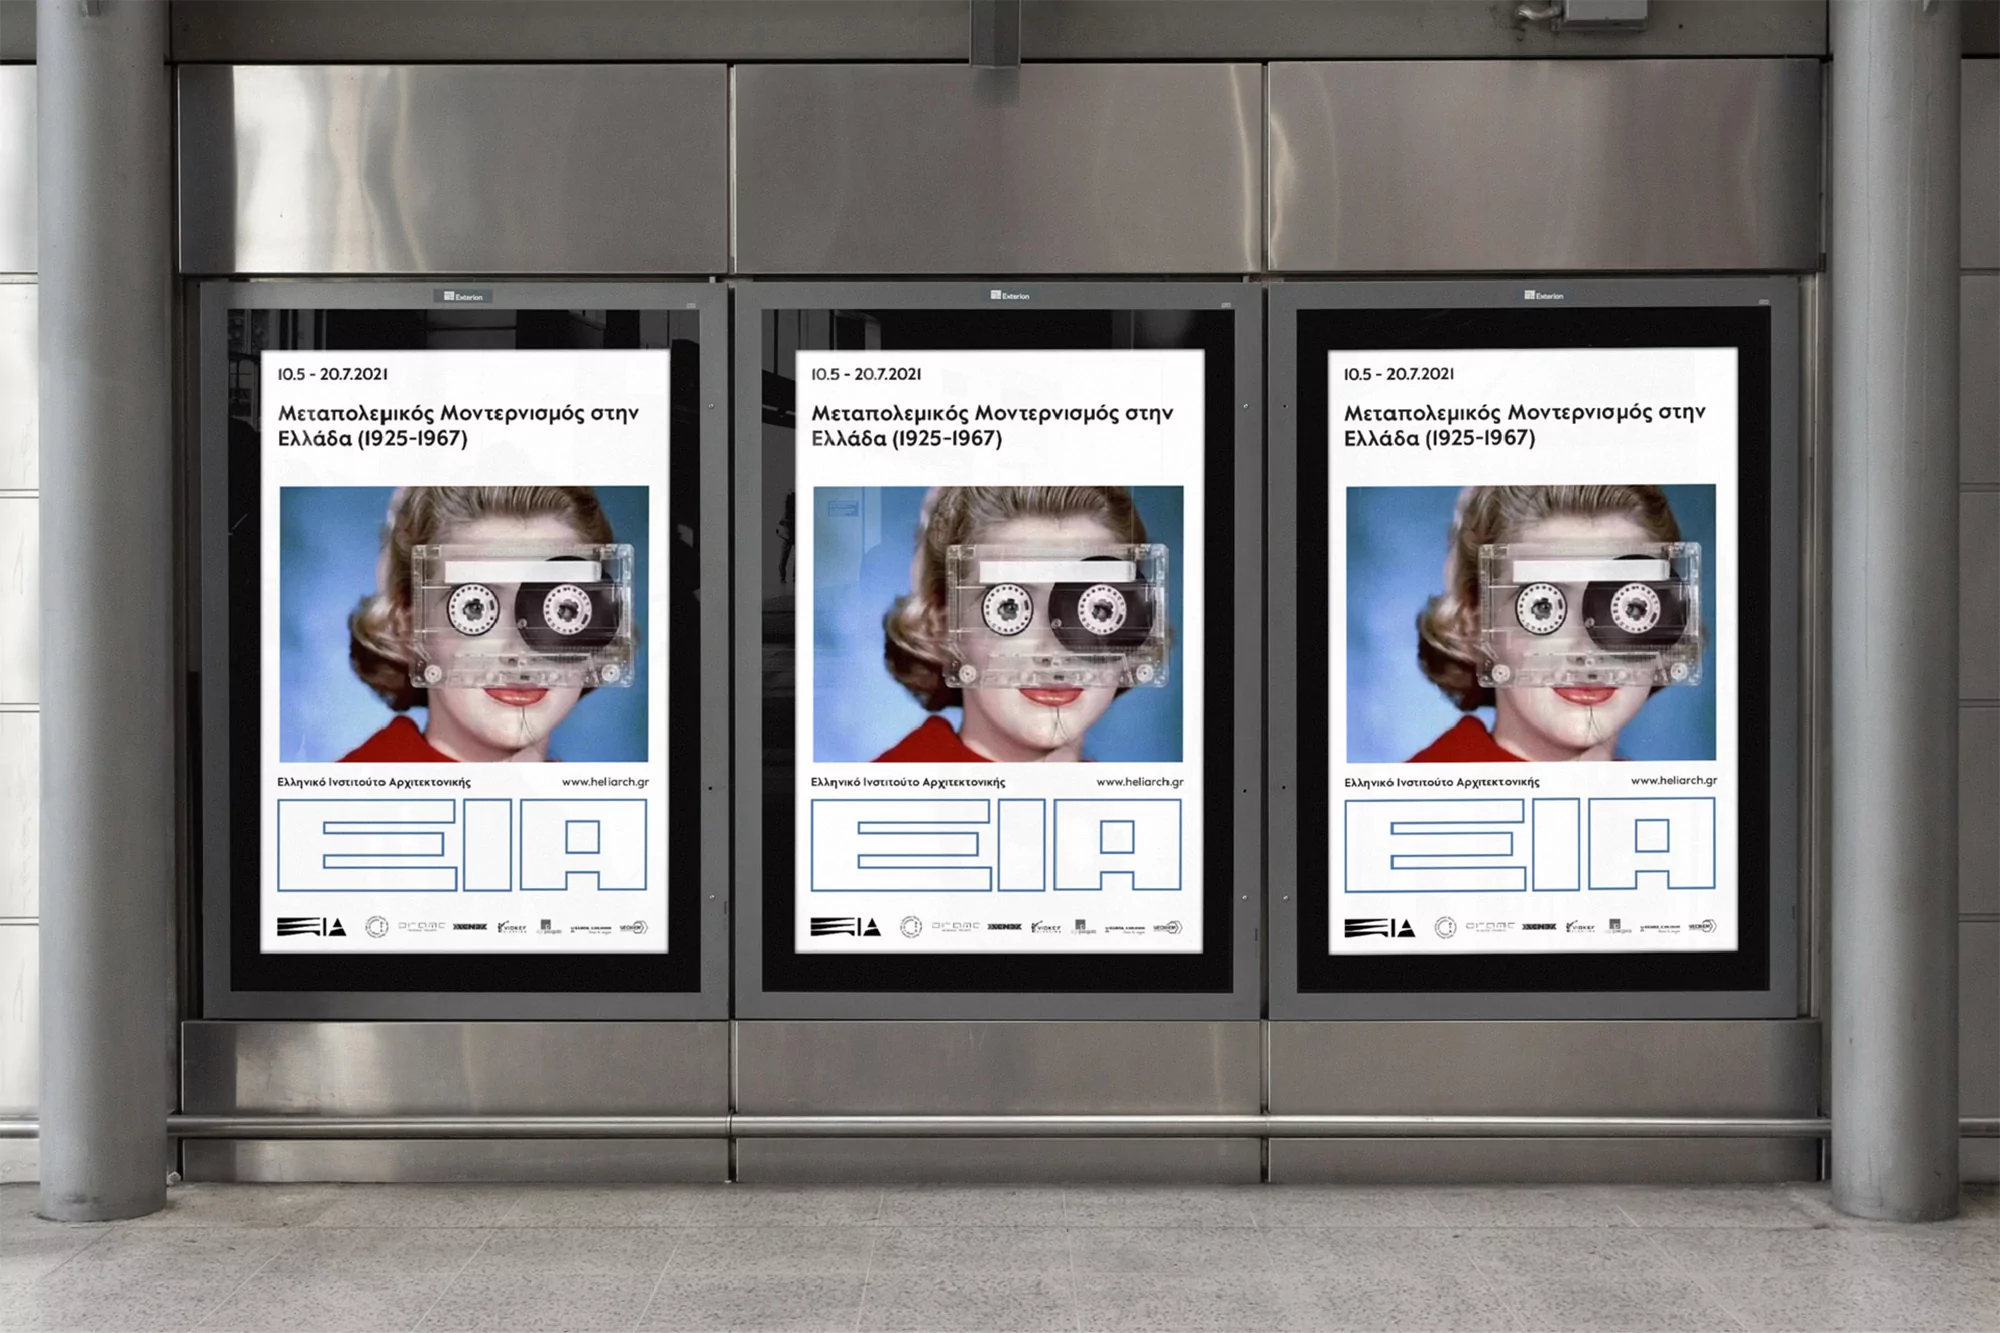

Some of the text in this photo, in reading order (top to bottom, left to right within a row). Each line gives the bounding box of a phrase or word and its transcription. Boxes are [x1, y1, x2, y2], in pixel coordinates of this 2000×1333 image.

[456, 293, 483, 301] Exterion
[1003, 293, 1030, 301] Exterion
[1536, 293, 1564, 301] Exterion
[279, 368, 305, 381] 10.5
[321, 368, 388, 381] 20.7.2021
[812, 368, 840, 381] 10.5
[855, 368, 921, 381] 20.7.2021
[1345, 368, 1372, 381] 10.5
[1387, 367, 1454, 381] 20.7.2021
[279, 404, 639, 424] Μεταπολεμικός Μοντερνισμός στην
[812, 404, 1174, 424] Μεταπολεμικός Μοντερνισμός στην
[1345, 404, 1706, 424] Μεταπολεμικός Μοντερνισμός στην
[279, 430, 468, 451] Ελλάδα (1925-1967)
[812, 430, 1003, 451] Ελλάδα (1925-1967)
[1345, 429, 1536, 450] Ελλάδα (1925-1967)
[278, 777, 472, 789] Ελληνικό Ινστιτούτο Αρχιτεκτονικής
[562, 777, 650, 789] www.heliarch.gr
[811, 777, 1005, 789] Ελληνικό Ινστιτούτο Αρχιτεκτονικής
[1097, 777, 1184, 789] www.heliarch.gr
[1345, 777, 1540, 789] Ελληνικό Ινστιτούτο Αρχιτεκτονικής
[1631, 776, 1718, 788] www.heliarch.gr
